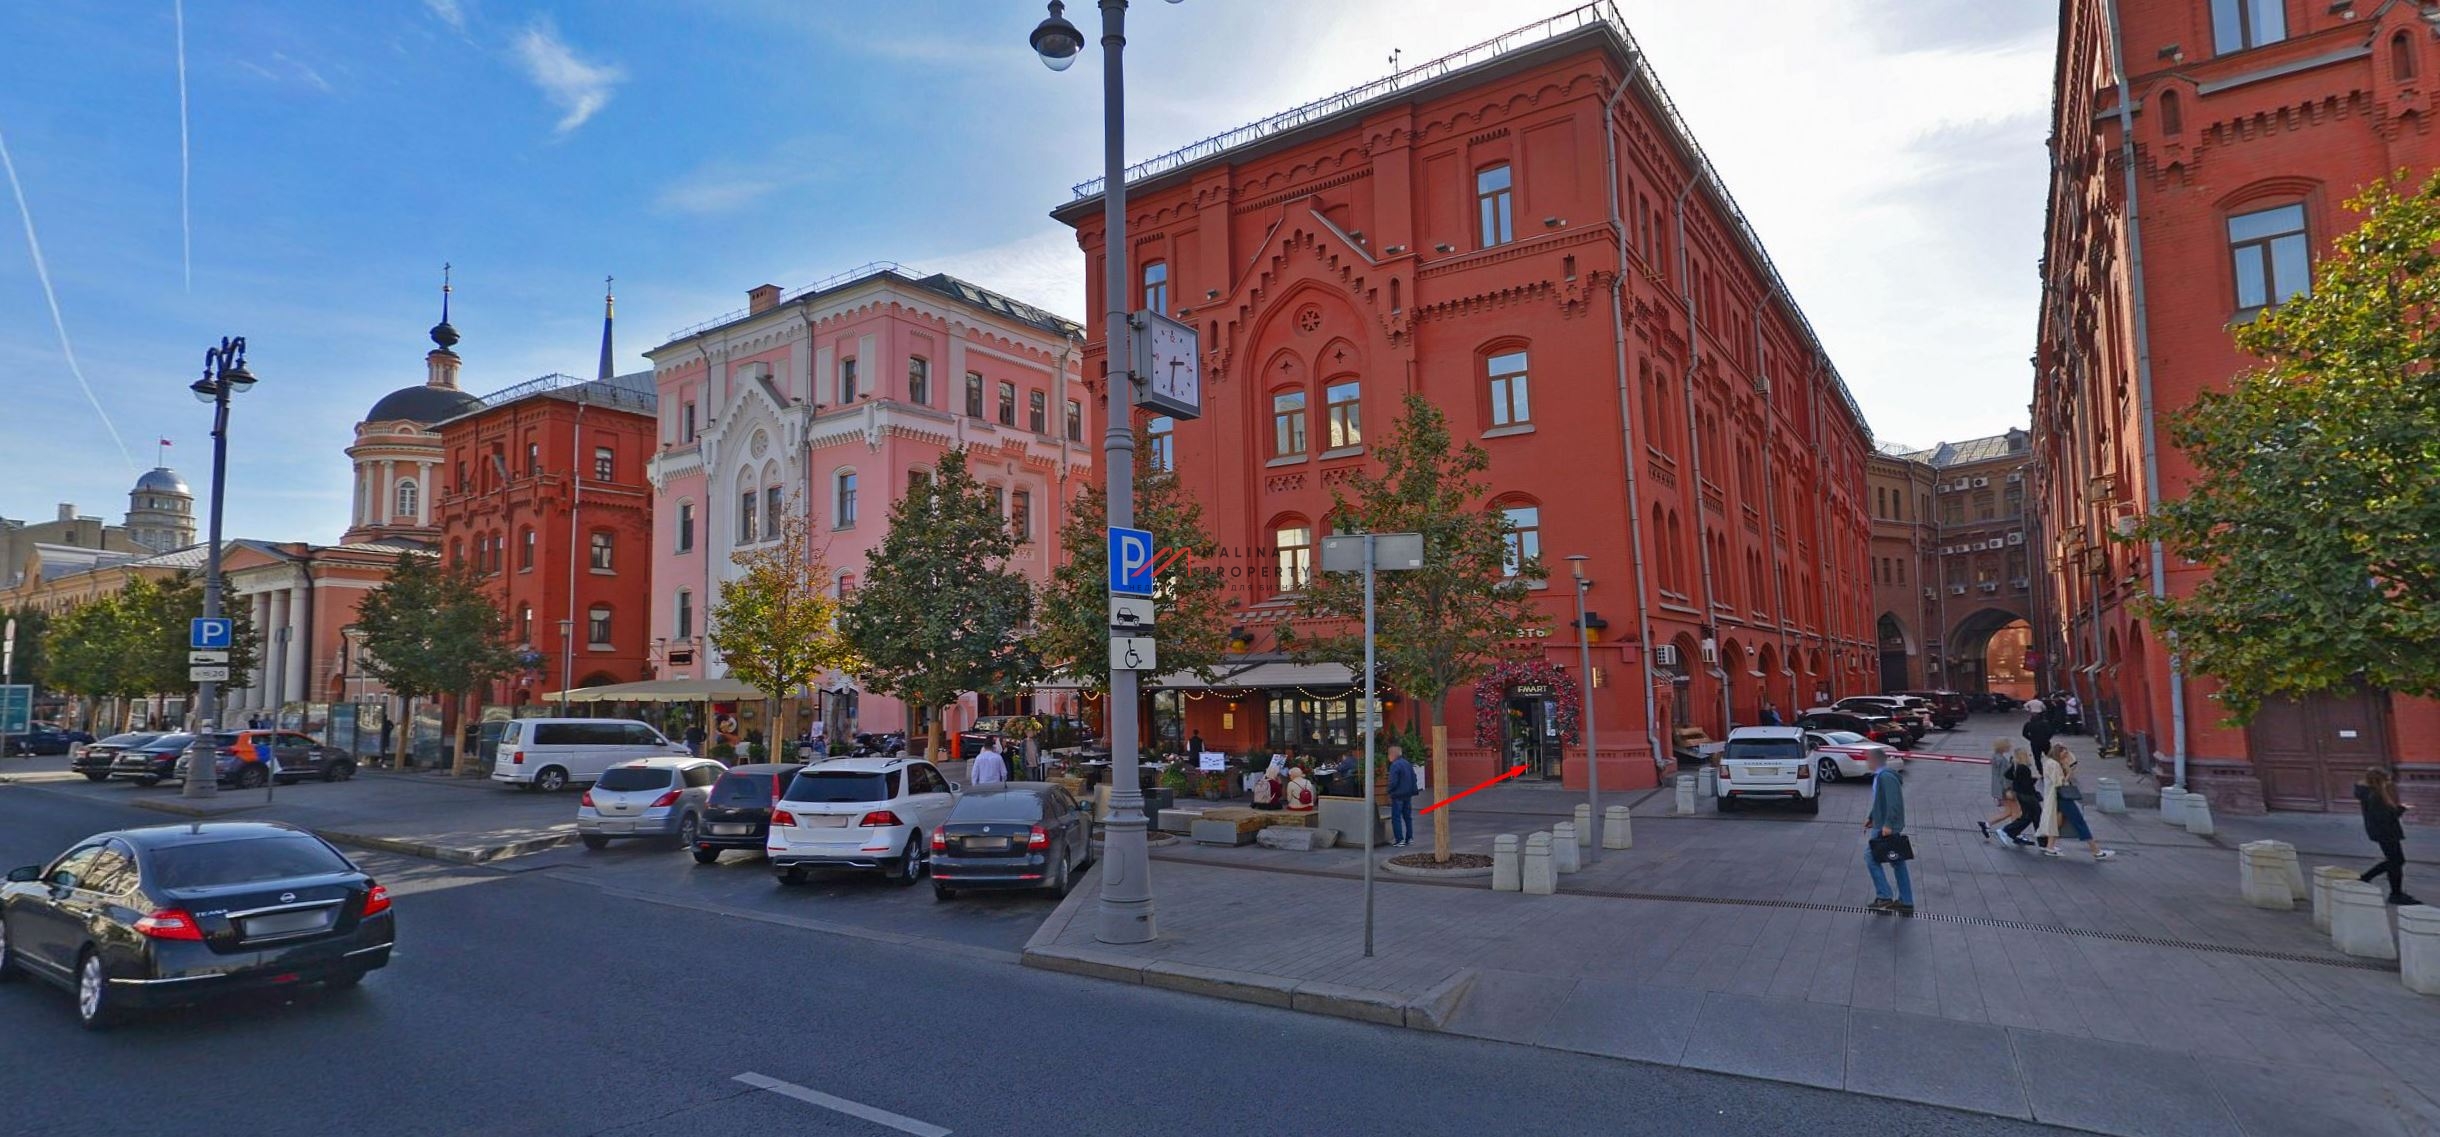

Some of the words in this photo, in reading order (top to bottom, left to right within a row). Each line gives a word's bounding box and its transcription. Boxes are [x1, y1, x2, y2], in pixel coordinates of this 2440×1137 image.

[1121, 535, 1146, 586] P
[203, 622, 224, 644] P
[1517, 685, 1548, 693] FMART
